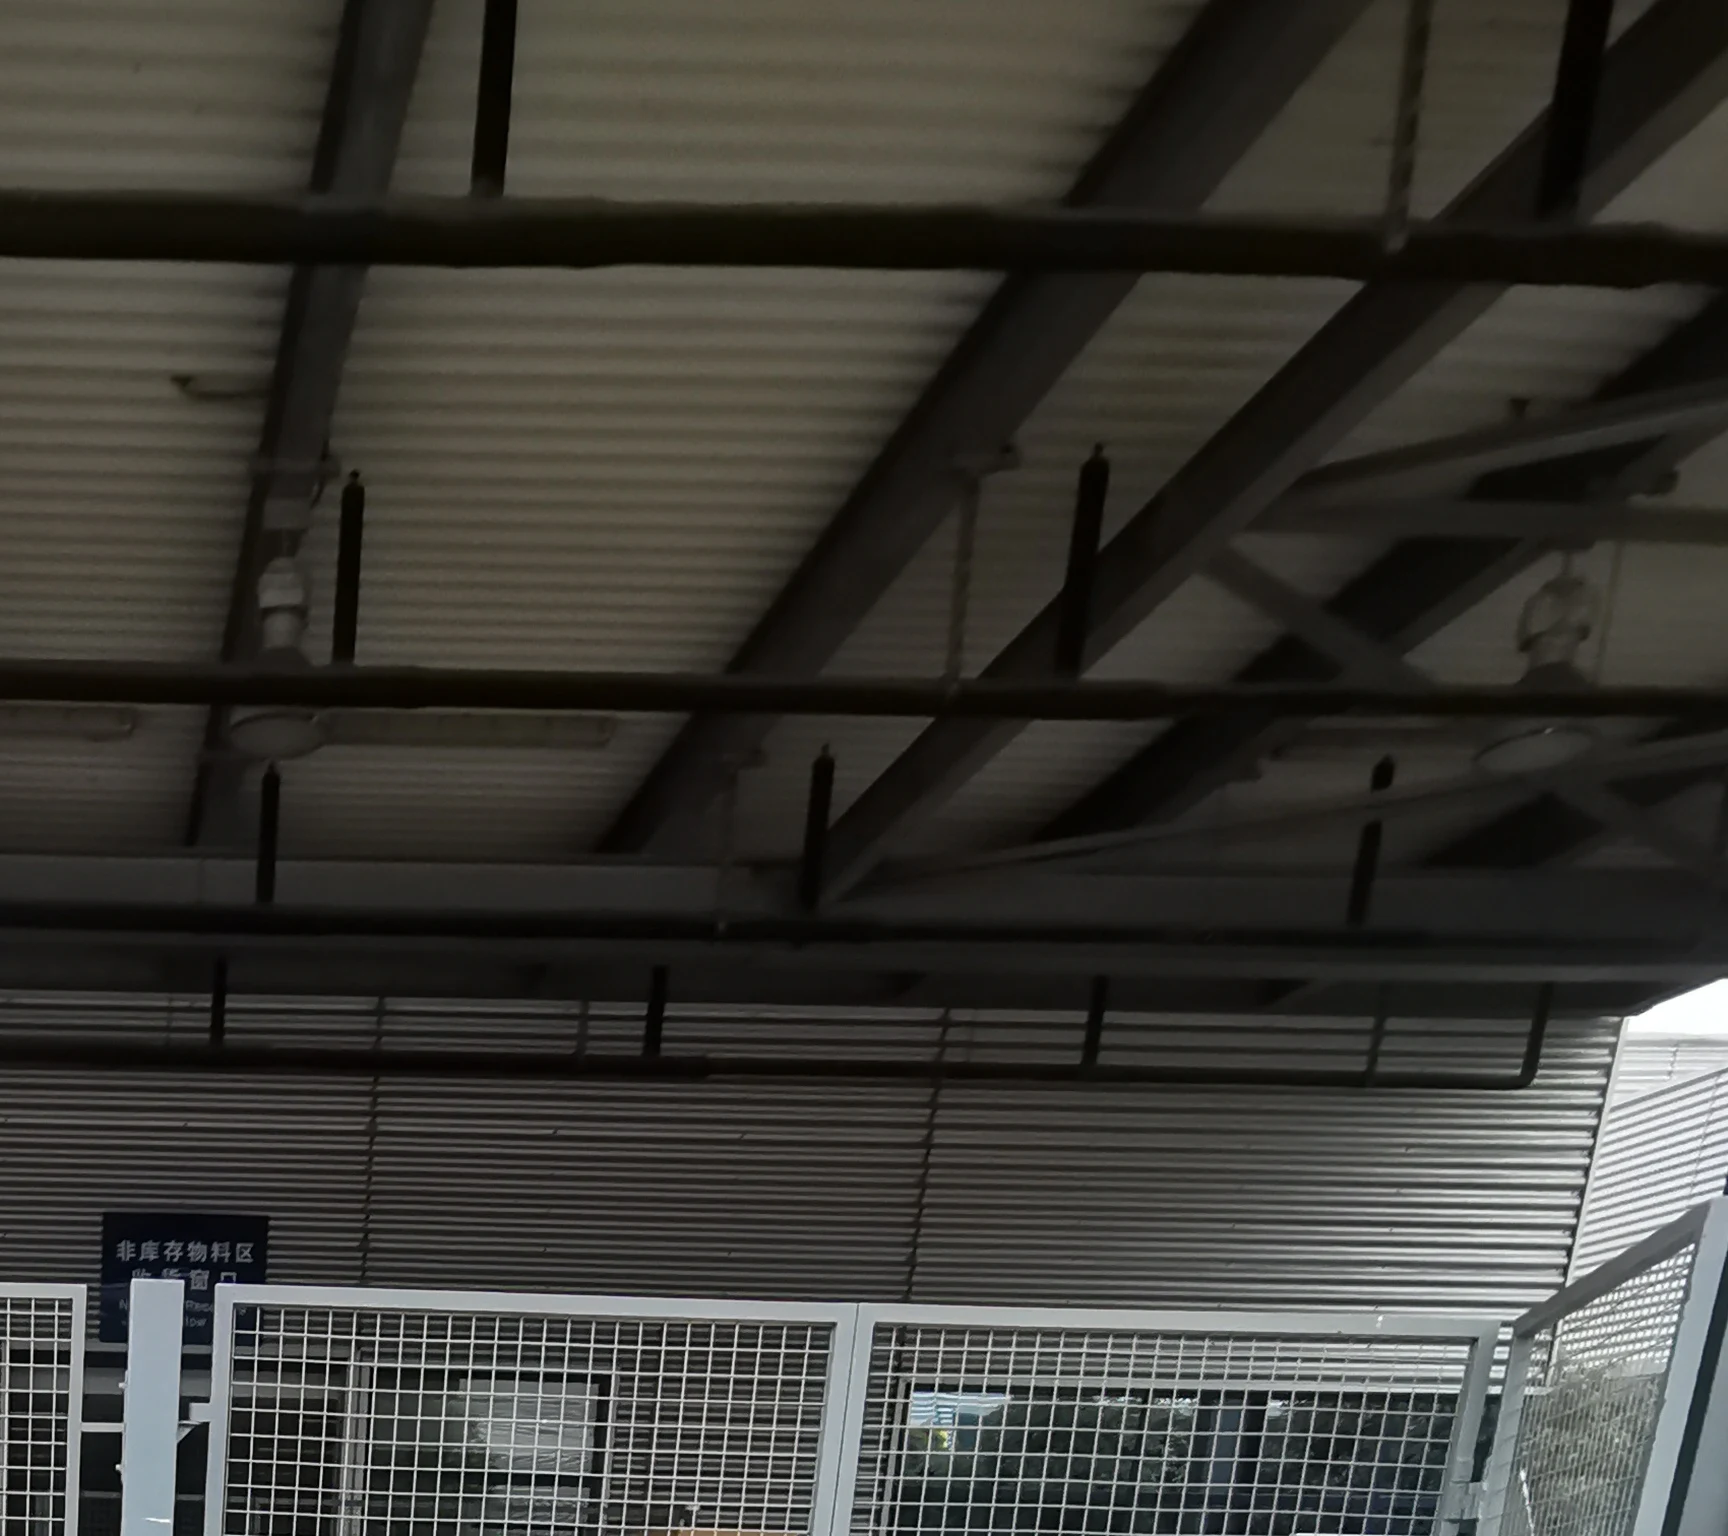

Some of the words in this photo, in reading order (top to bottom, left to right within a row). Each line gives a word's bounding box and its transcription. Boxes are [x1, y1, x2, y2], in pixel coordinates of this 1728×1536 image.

[116, 1239, 254, 1263] 非库存物料区
